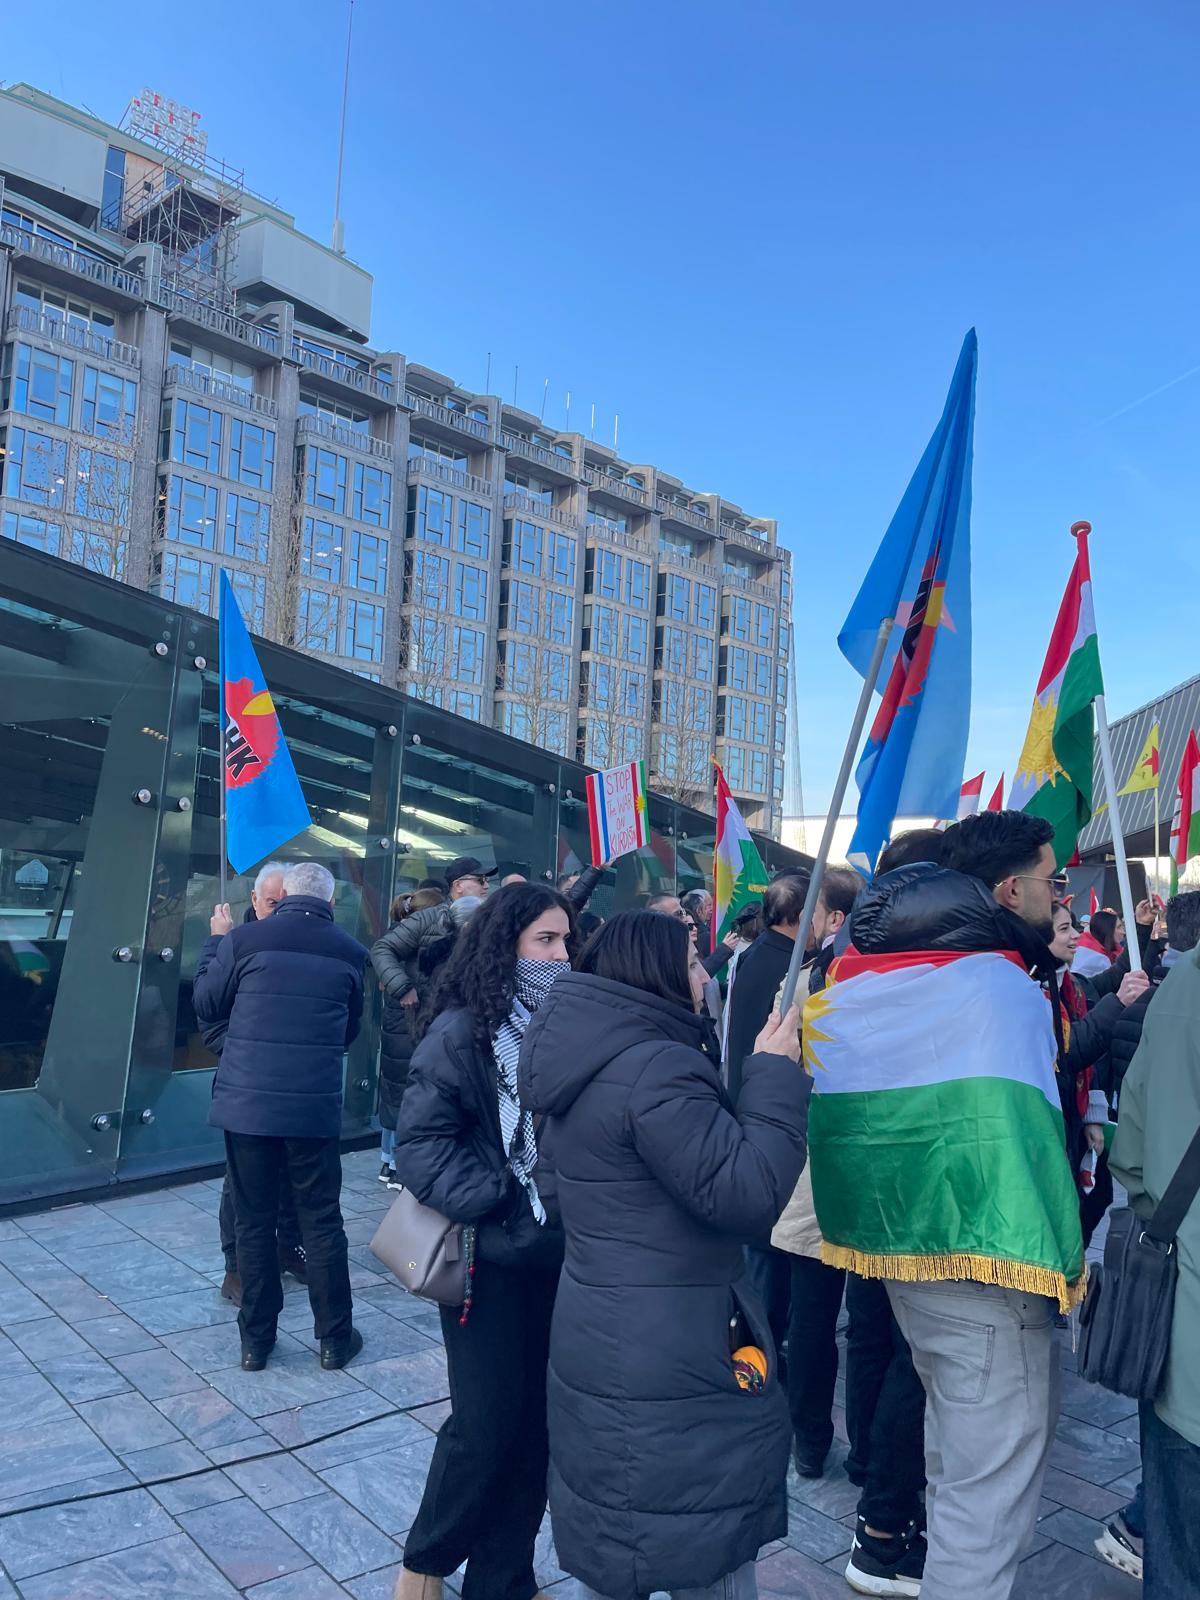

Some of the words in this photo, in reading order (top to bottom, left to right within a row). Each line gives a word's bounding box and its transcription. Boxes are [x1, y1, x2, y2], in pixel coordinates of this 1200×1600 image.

[605, 769, 631, 796] STOP
[617, 793, 633, 813] WAR
[616, 816, 626, 831] ON
